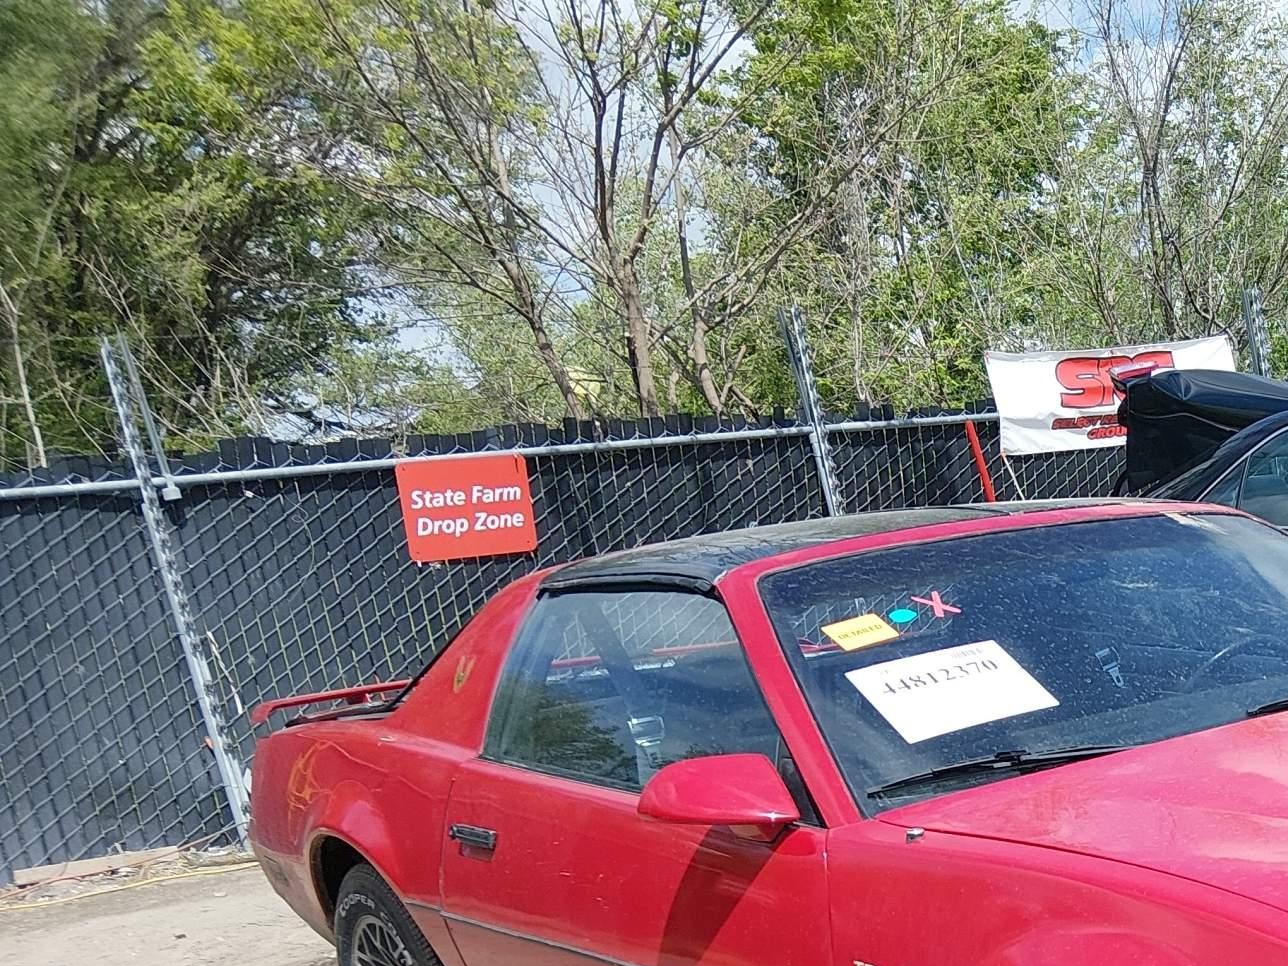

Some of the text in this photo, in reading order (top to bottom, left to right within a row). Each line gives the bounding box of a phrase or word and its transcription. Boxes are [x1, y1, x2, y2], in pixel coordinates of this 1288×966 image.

[1087, 425, 1127, 440] GROU
[411, 485, 521, 509] State Farm
[417, 511, 524, 537] Drop Zone
[883, 659, 999, 694] 44812370
